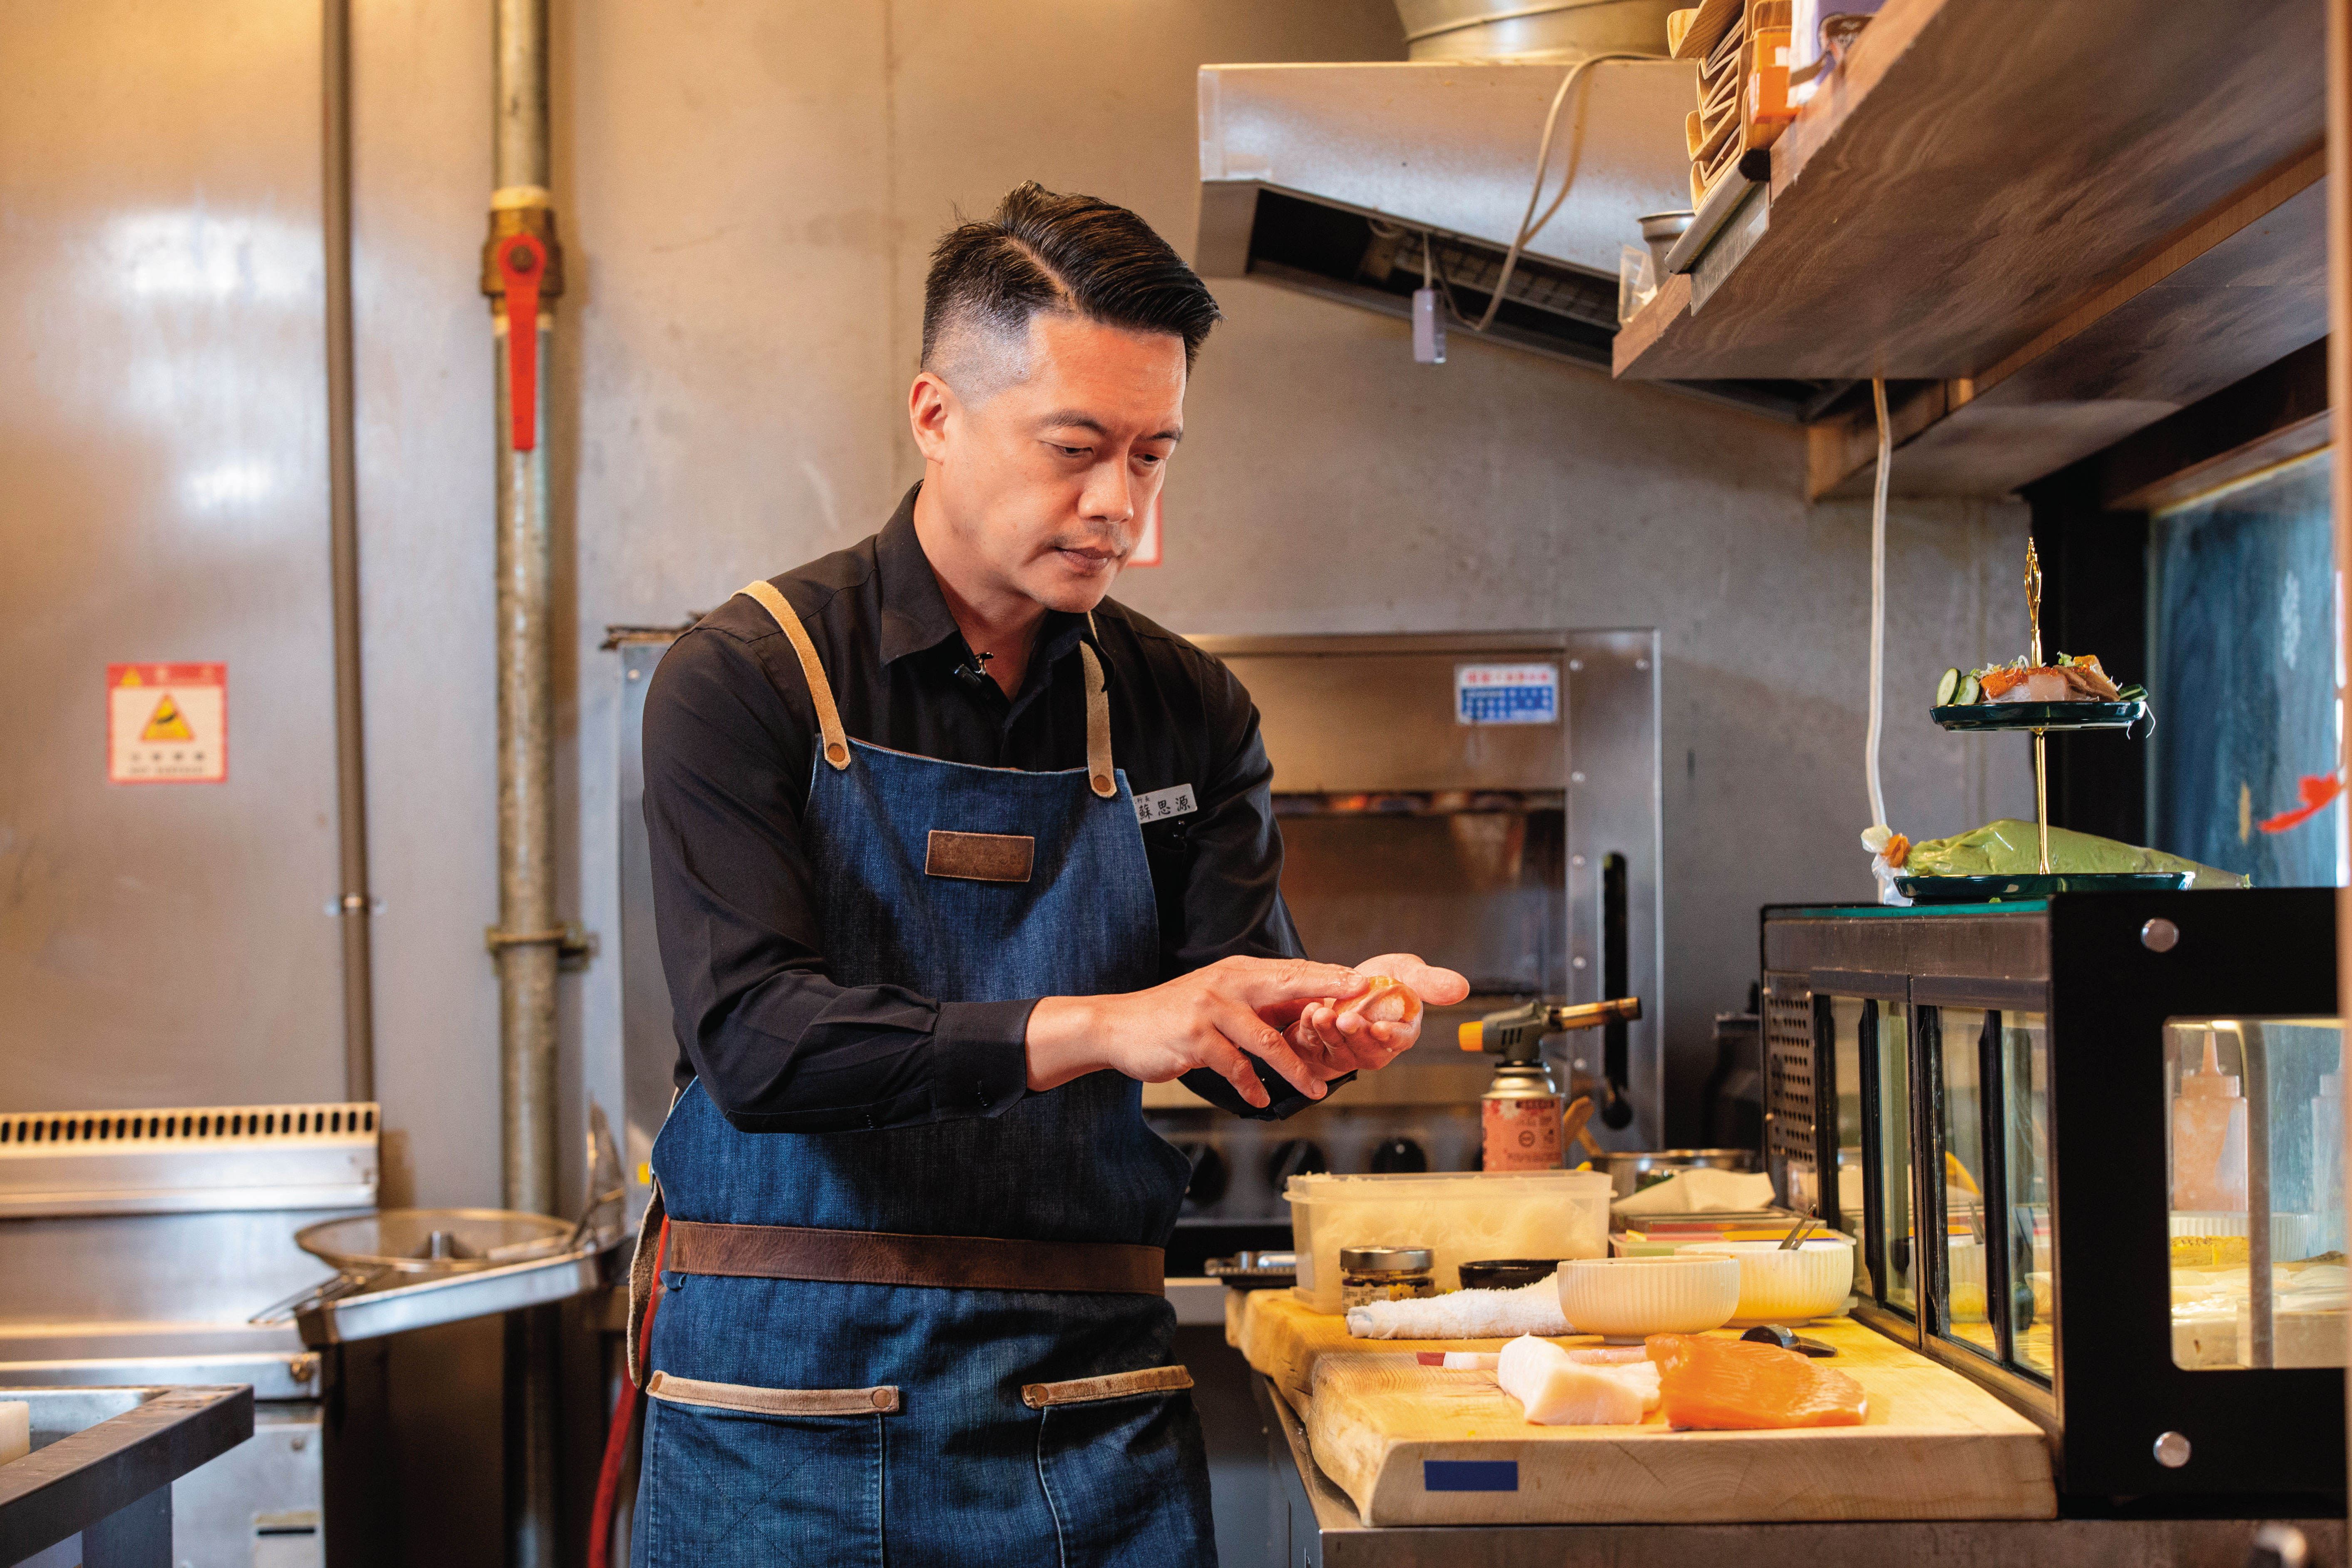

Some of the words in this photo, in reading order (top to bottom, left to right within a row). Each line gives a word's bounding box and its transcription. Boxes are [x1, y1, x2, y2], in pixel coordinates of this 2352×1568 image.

[1134, 795, 1150, 804] 行長
[1139, 795, 1191, 820] 蘇思源
